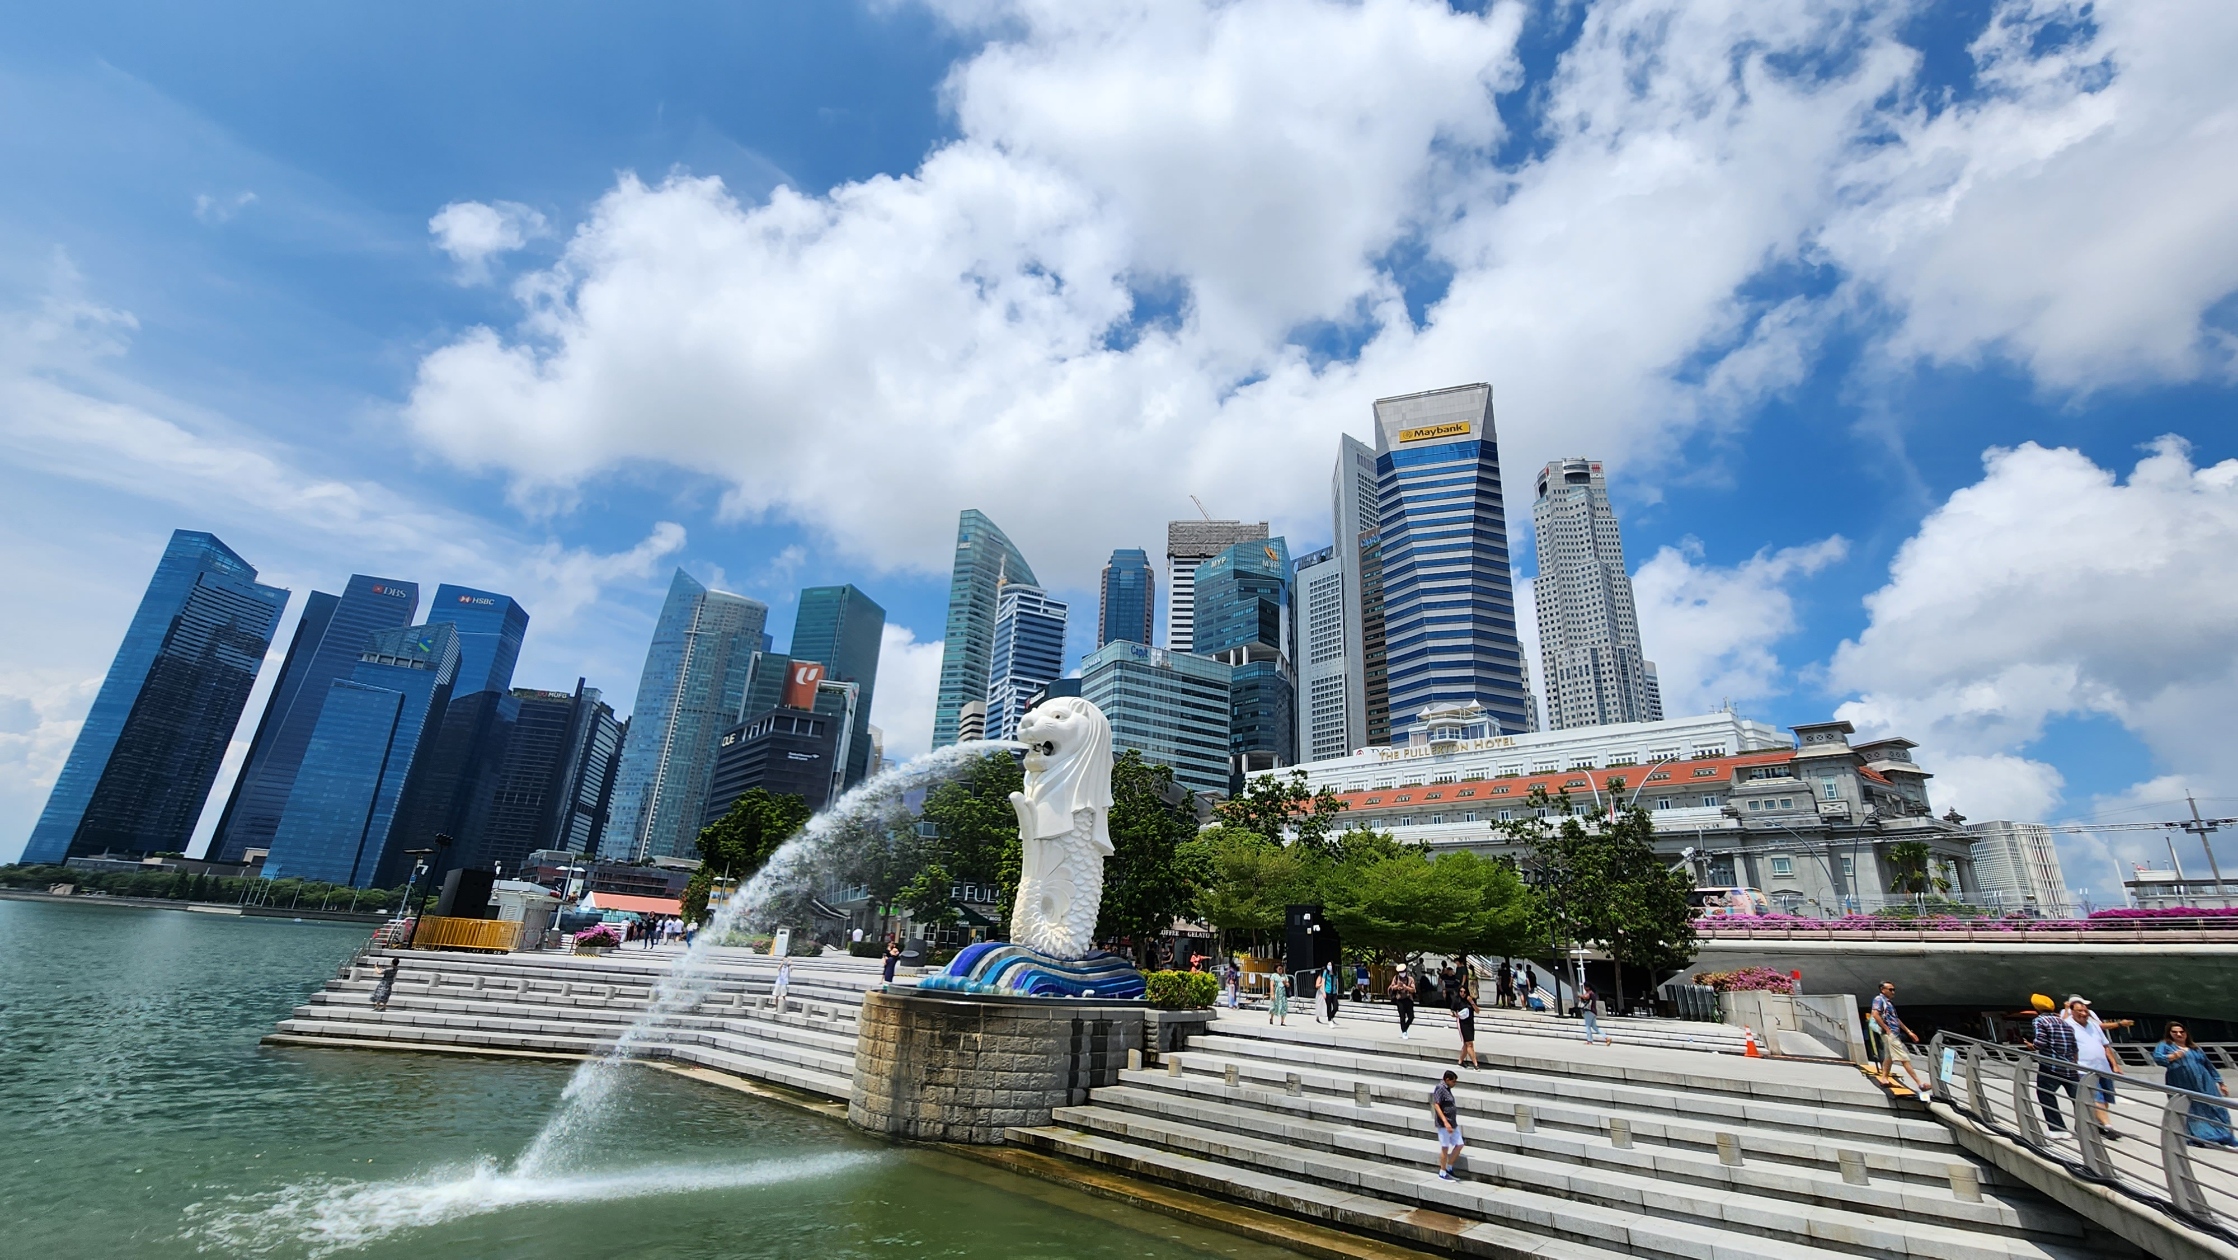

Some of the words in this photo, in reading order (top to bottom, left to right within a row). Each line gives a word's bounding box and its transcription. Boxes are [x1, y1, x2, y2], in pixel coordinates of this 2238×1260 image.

[1414, 424, 1463, 437] Maybank
[1210, 556, 1227, 569] MYP
[383, 586, 407, 599] DBS
[472, 597, 495, 606] HSBC
[548, 691, 567, 699] MUFG
[721, 733, 737, 747] OUE
[1379, 750, 1399, 761] THE
[1404, 742, 1469, 758] FULLERTON
[1474, 736, 1517, 750] HOTEL
[1187, 931, 1210, 939] GELATO
